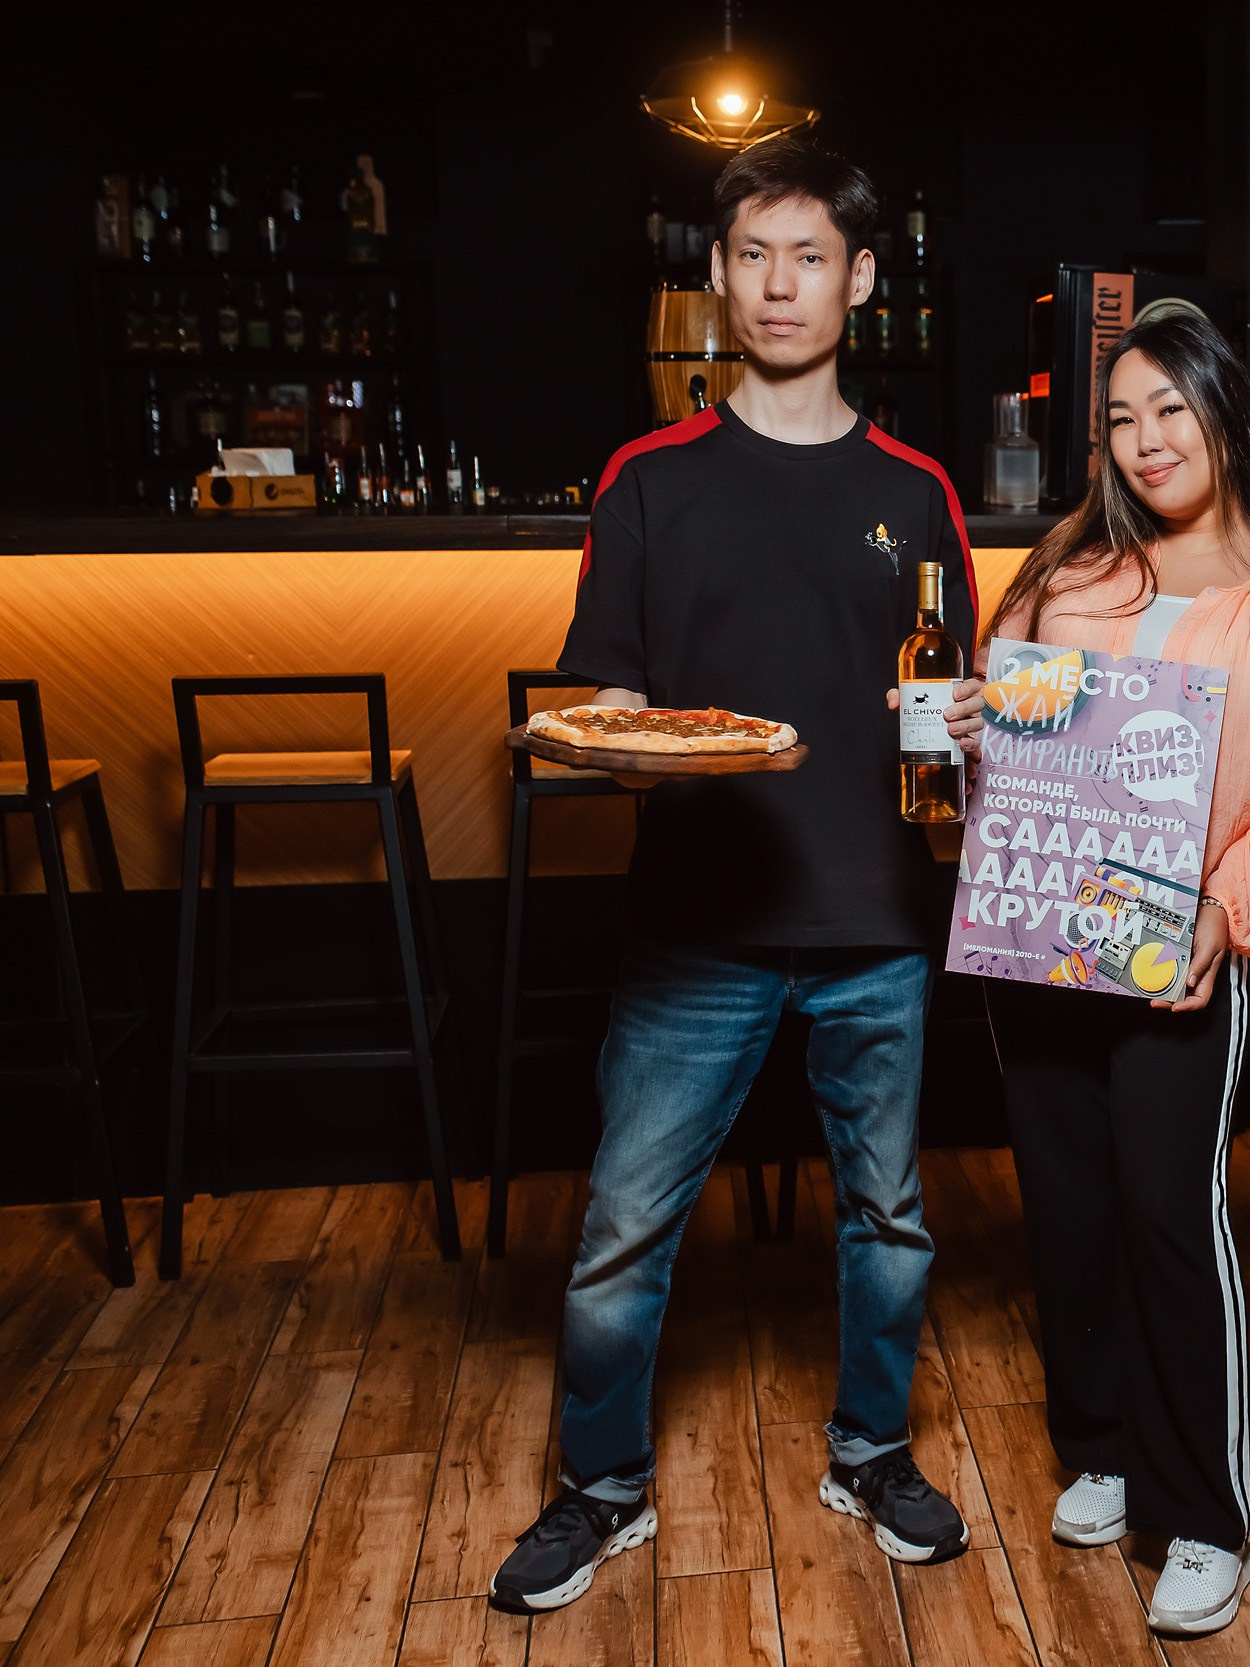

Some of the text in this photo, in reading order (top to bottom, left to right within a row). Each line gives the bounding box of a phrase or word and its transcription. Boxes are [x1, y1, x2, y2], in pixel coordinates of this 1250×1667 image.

[1001, 657, 1150, 701] 2 МЕСТО
[994, 686, 1074, 732] ЖАЙ
[1116, 725, 1194, 757] КВИЗ
[986, 773, 1080, 801] КОМАНДЕ,
[983, 793, 1187, 834] КОТОРАЯ БЫЛА ПОЧТИ
[978, 813, 1201, 875] САААААА
[967, 889, 1144, 945] КРУТОЙ
